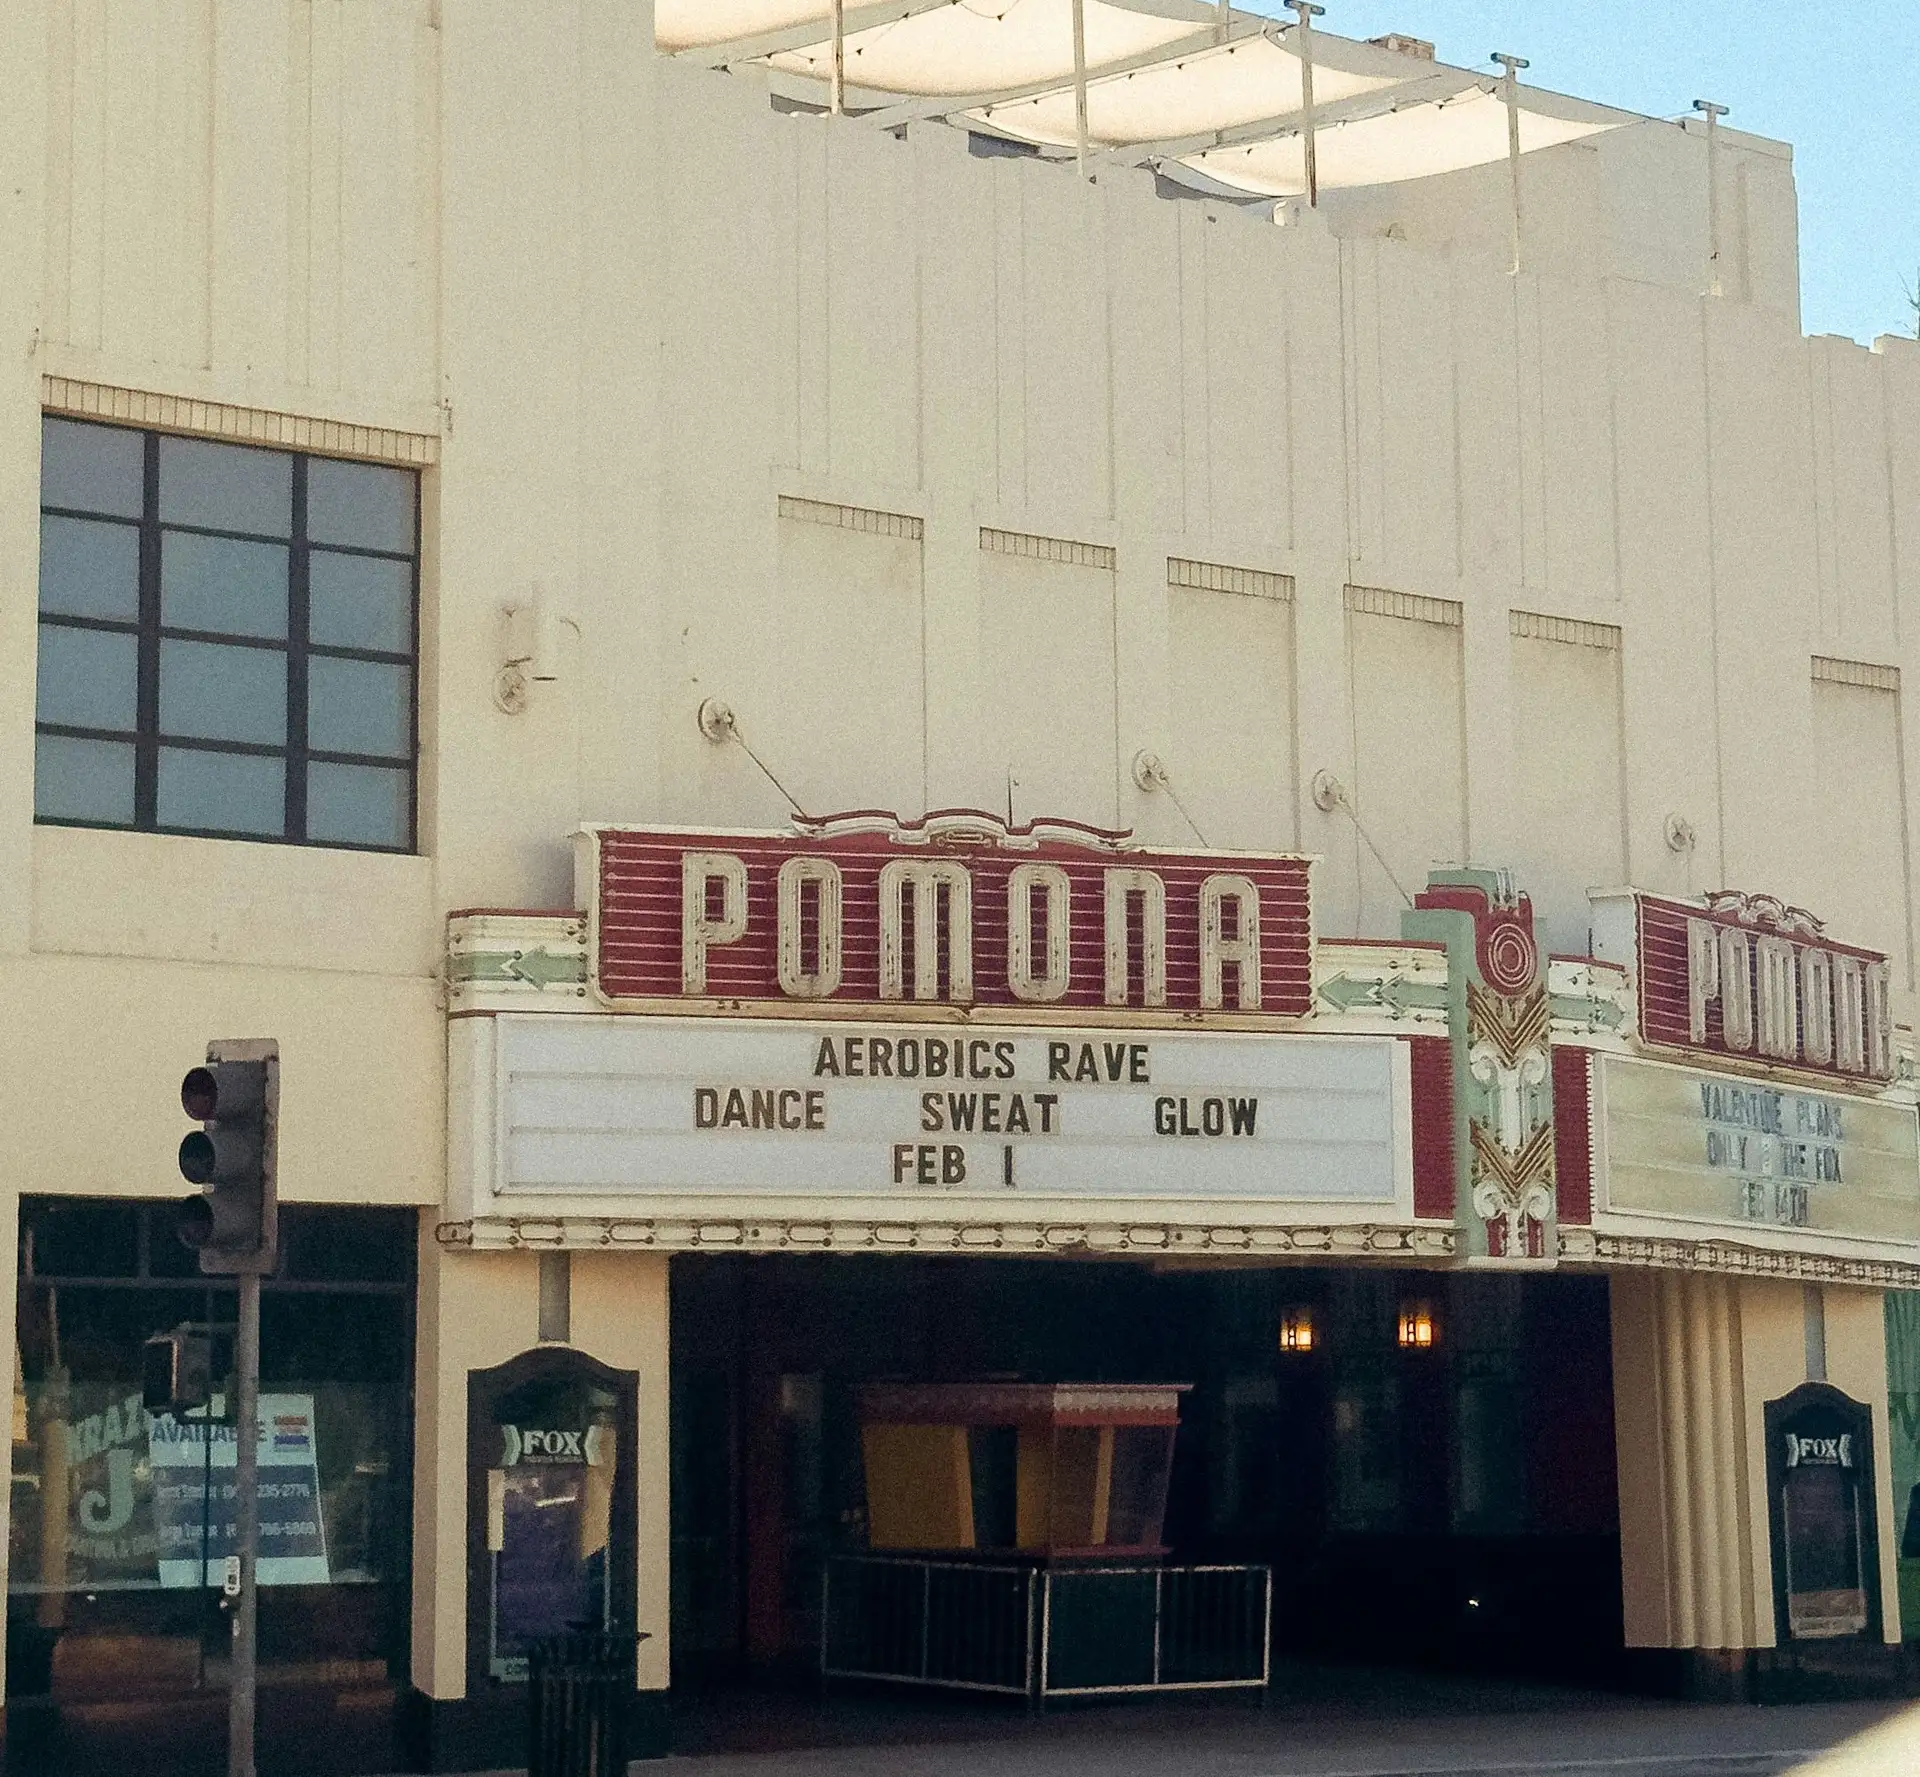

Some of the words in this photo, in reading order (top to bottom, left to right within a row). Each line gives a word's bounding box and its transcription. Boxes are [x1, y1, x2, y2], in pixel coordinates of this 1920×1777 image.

[682, 853, 1261, 1010] POMONA
[1686, 917, 1892, 1080] POMONA
[814, 1036, 1016, 1079] AEROBICS
[1048, 1042, 1150, 1083] RAVE
[694, 1087, 825, 1130] DANCE
[921, 1092, 1058, 1133] SWEAT
[1154, 1096, 1258, 1137] GLOW
[893, 1144, 966, 1185] FEB
[523, 1430, 582, 1455] FOX
[1800, 1438, 1838, 1457] FOX
